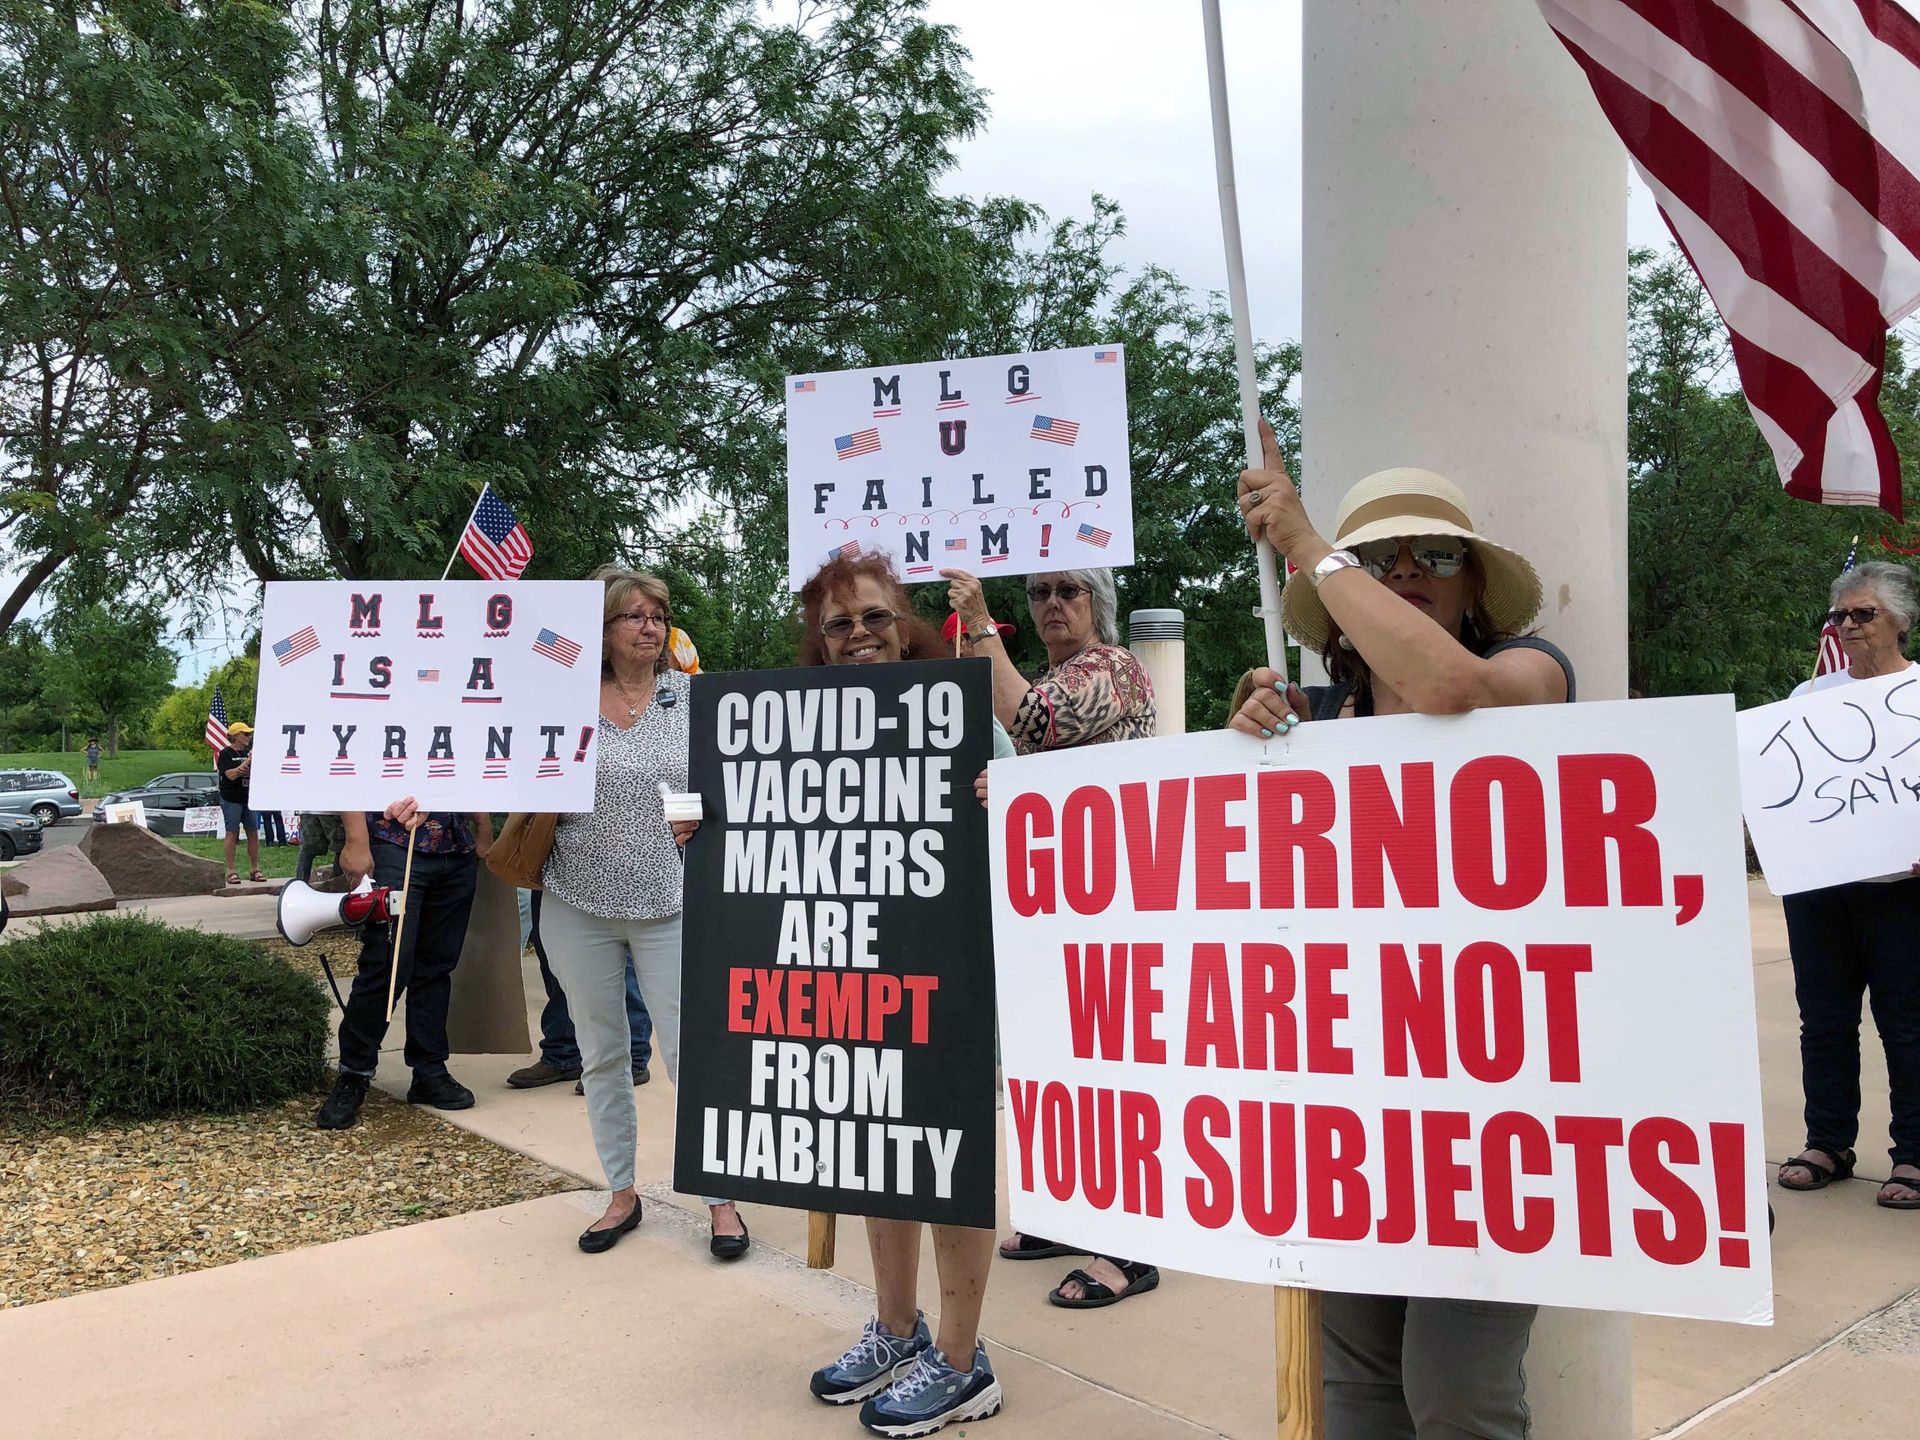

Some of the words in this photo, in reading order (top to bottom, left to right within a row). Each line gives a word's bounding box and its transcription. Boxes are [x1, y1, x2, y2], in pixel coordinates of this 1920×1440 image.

[938, 419, 967, 456] U
[814, 464, 1108, 514] FAILED
[332, 653, 393, 689] IS
[466, 657, 495, 690] A
[281, 724, 595, 763] TYRANT!
[717, 681, 964, 756] COVID-19
[722, 756, 953, 824] VACCINE
[723, 828, 945, 898] MAKERS
[1005, 753, 1704, 926] GOVERNOR,
[776, 900, 879, 968] ARE
[728, 967, 939, 1044] EXEMPT
[1063, 943, 1168, 1064] WE
[1183, 942, 1354, 1076] ARE
[1378, 940, 1593, 1084] NOT
[750, 1039, 903, 1118] FROM
[702, 1107, 963, 1199] LIABILITY
[1008, 1079, 1164, 1219] YOUR
[1183, 1093, 1751, 1269] SUBJECTS!
